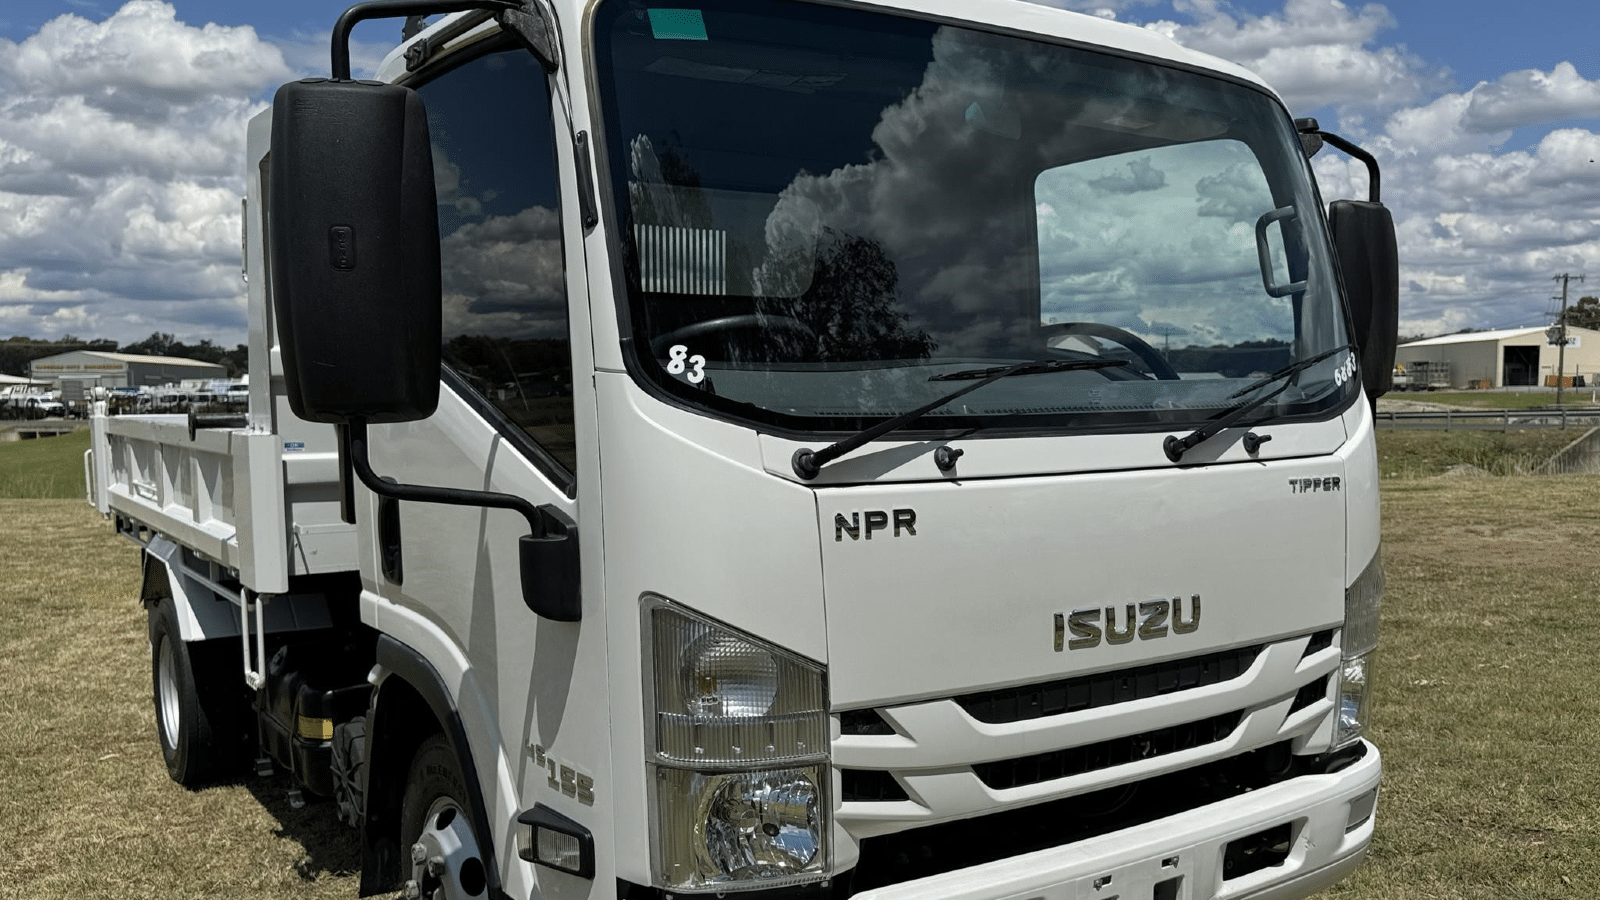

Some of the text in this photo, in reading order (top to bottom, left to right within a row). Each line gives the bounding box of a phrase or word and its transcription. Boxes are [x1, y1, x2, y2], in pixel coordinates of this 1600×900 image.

[338, 230, 347, 268] ISUZU
[667, 344, 706, 384] 83
[1334, 351, 1357, 387] 6883
[1288, 476, 1341, 494] TIPPER
[835, 508, 917, 542] NPR
[1053, 594, 1201, 653] ISUZU
